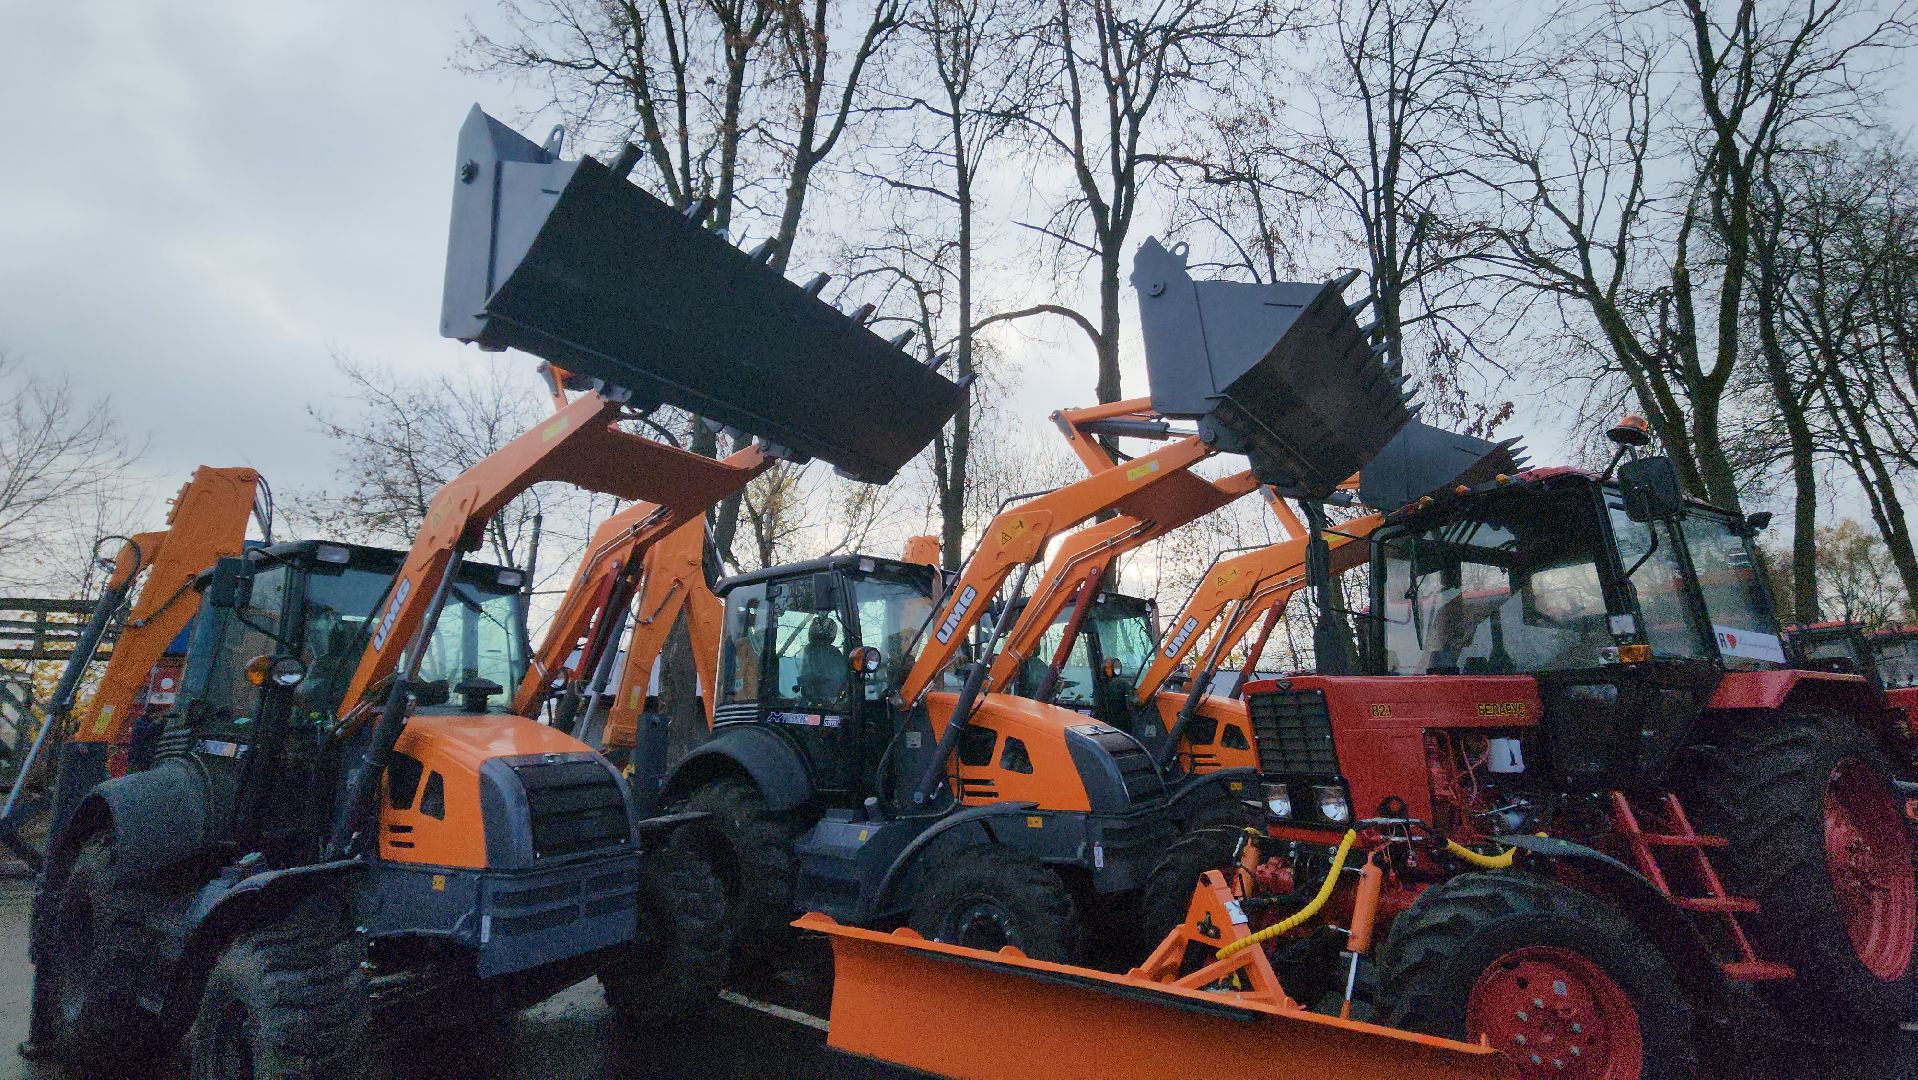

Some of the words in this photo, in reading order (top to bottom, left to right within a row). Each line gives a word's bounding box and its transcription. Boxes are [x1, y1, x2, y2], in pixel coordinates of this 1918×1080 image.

[374, 578, 410, 651] UMG
[936, 585, 977, 644] UMG
[1164, 616, 1199, 659] UMG
